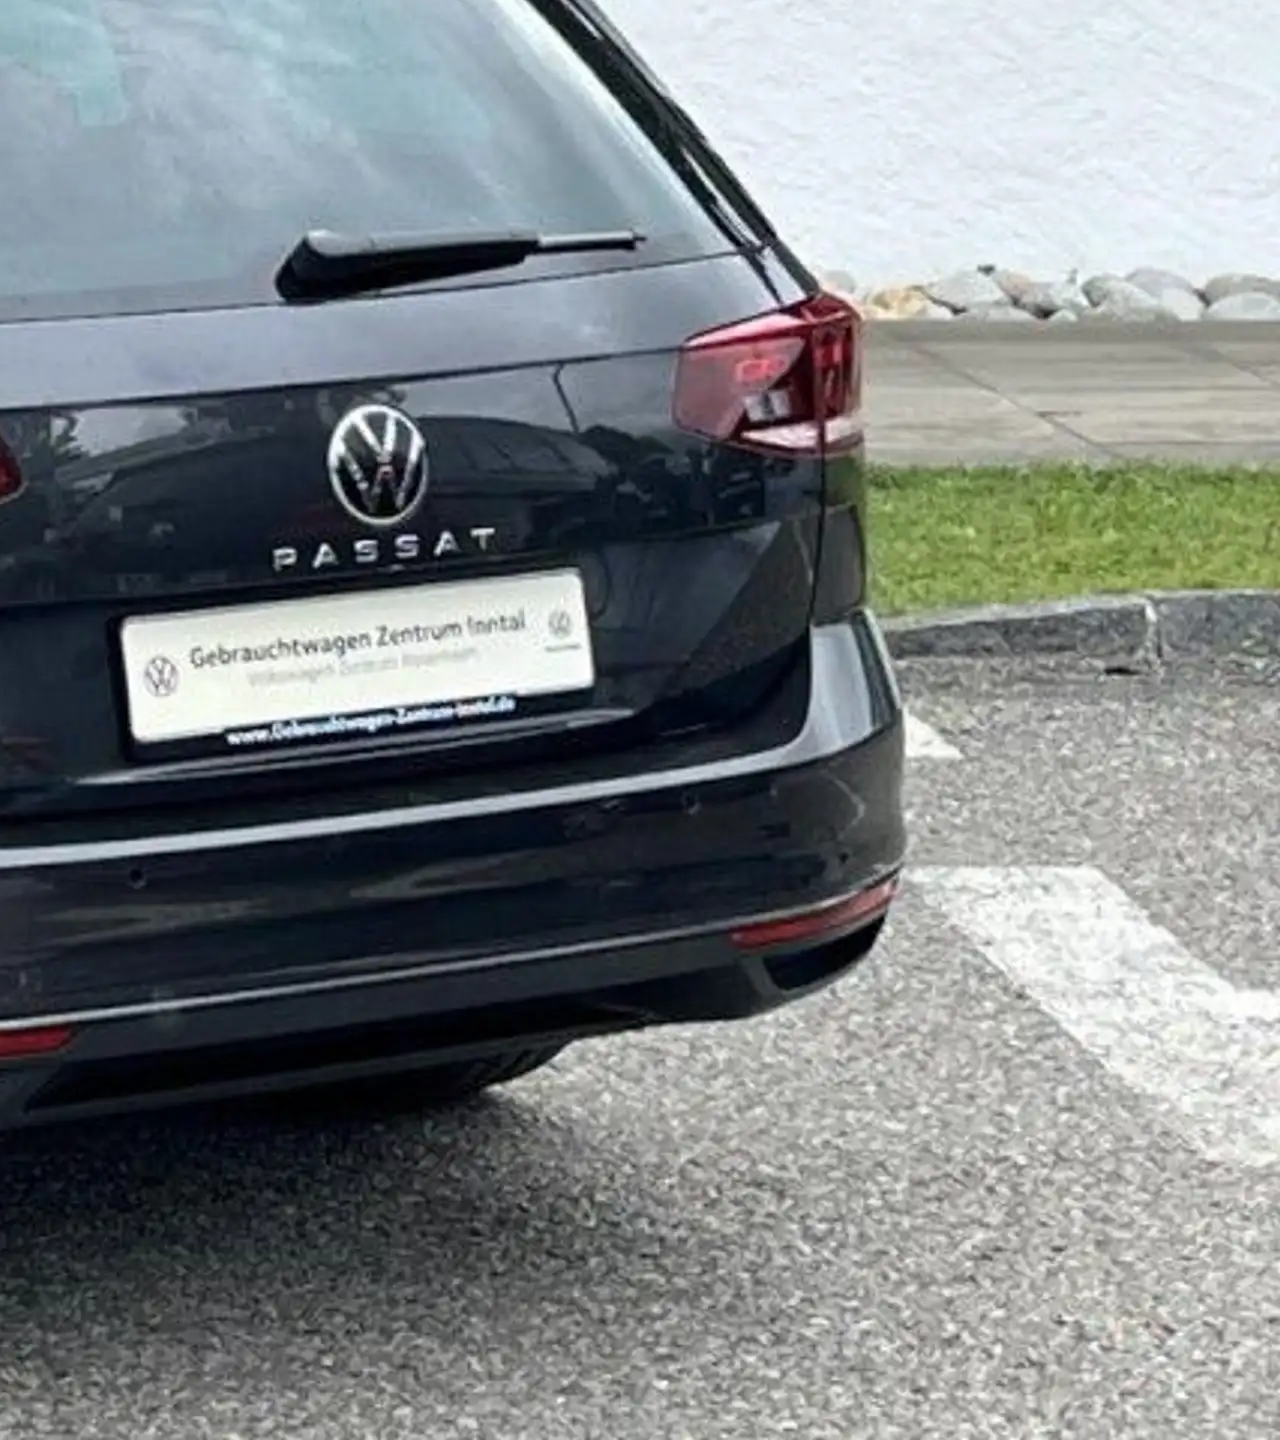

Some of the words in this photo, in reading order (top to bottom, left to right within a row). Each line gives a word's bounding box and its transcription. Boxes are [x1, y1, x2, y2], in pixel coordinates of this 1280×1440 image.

[271, 526, 496, 573] PASSAT
[189, 631, 372, 669] Gebrauchtwagen
[376, 622, 462, 647] Zentrum
[467, 607, 526, 635] Inntal
